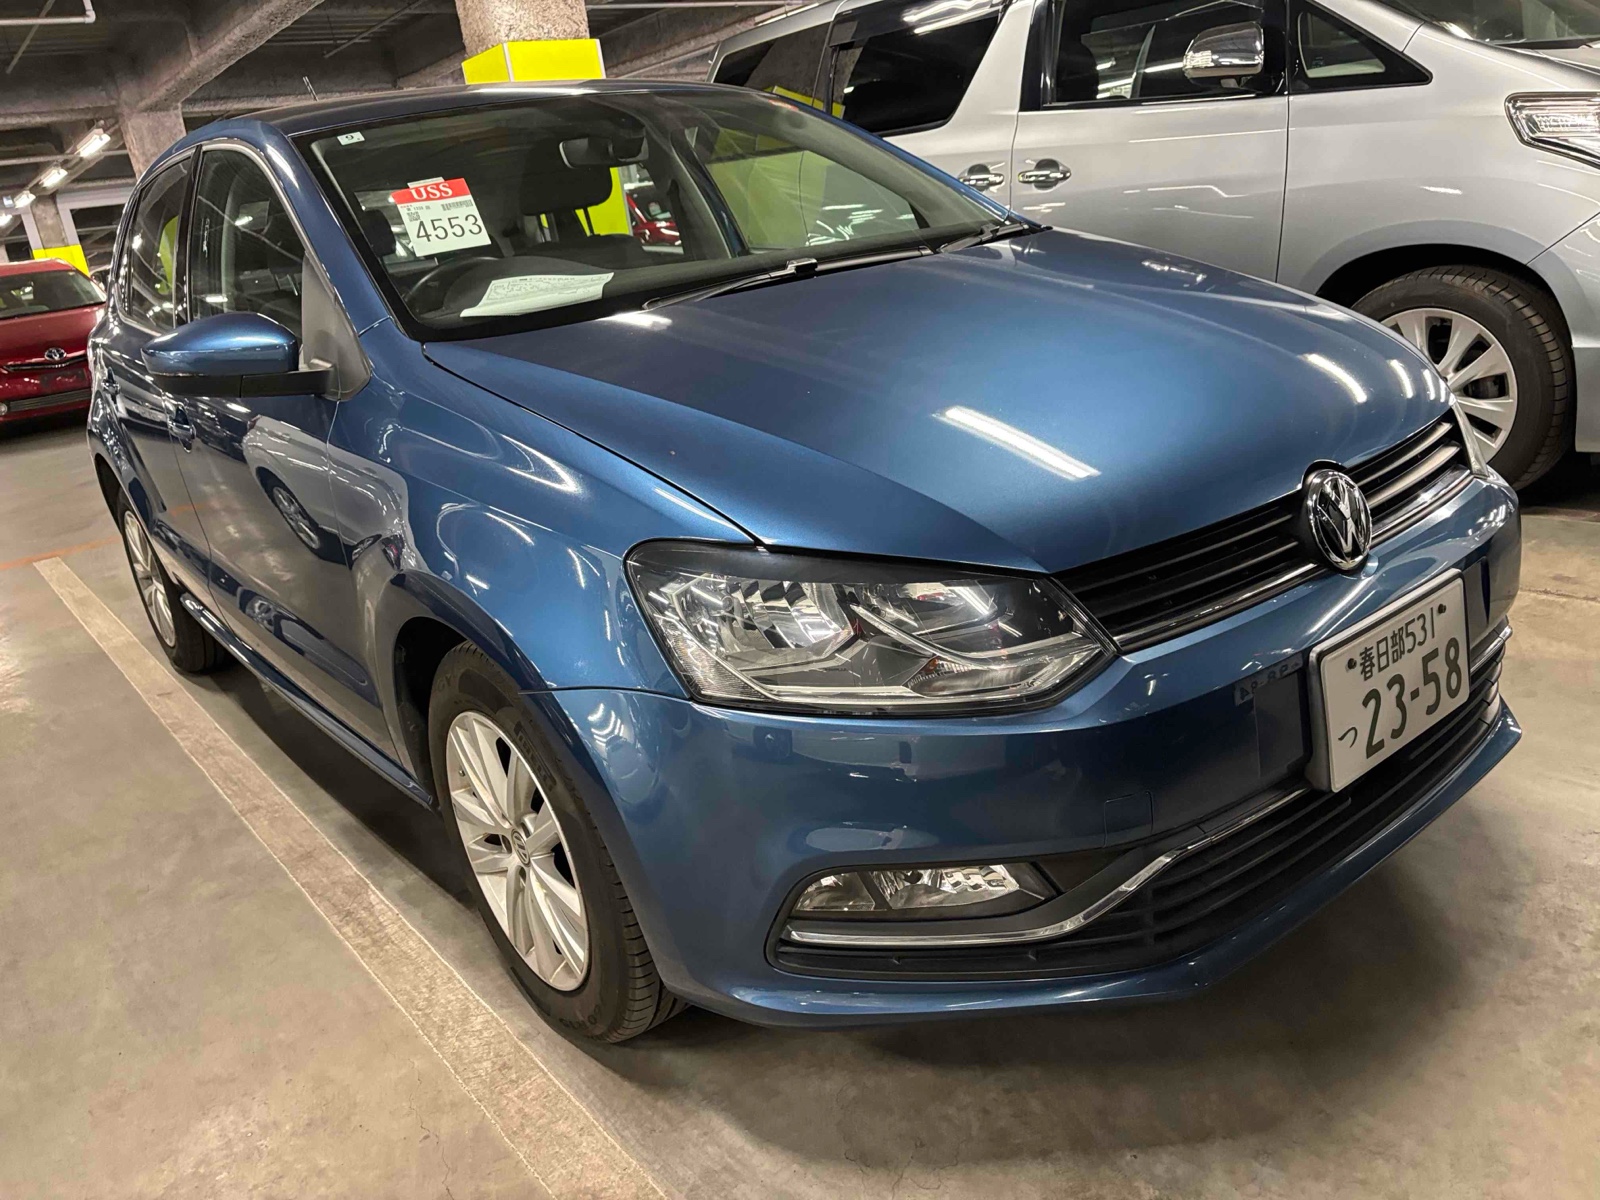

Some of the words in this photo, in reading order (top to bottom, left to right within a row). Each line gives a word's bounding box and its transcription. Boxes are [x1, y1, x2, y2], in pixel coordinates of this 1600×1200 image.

[410, 183, 453, 200] USS
[416, 214, 483, 242] 4553
[1338, 726, 1358, 748] つ
[1361, 637, 1462, 760] 23-58
